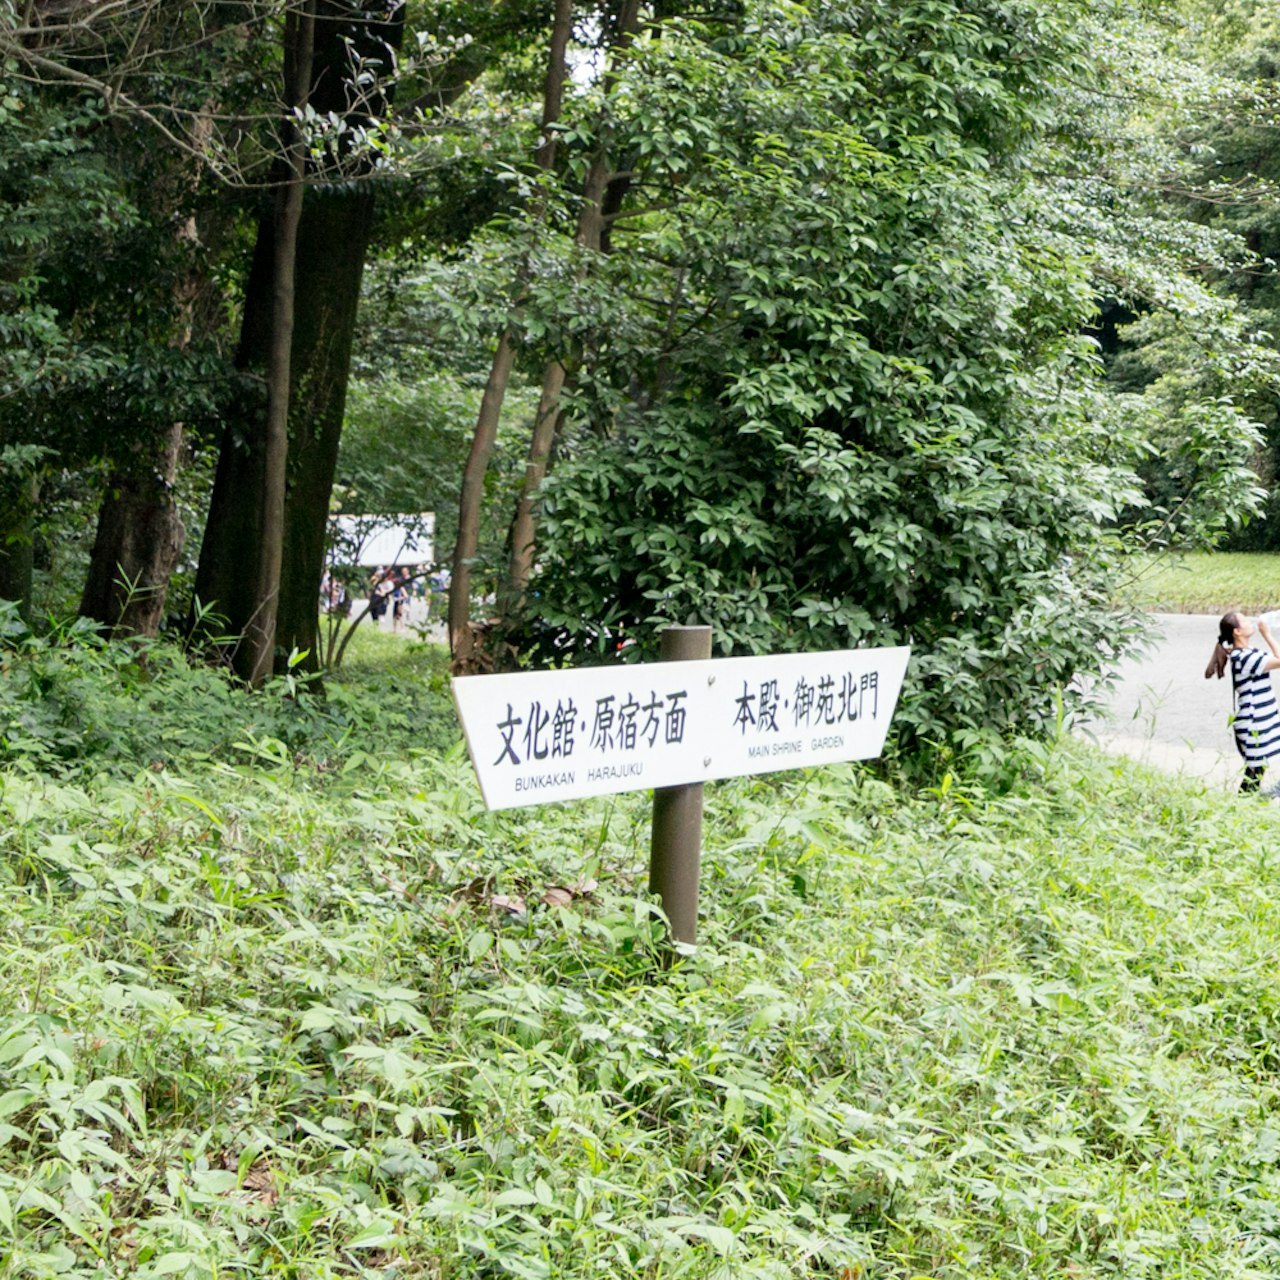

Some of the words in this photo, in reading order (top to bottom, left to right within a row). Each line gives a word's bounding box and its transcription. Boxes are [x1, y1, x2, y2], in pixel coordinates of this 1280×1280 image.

[733, 671, 879, 736] 本殿・御苑北門
[493, 690, 688, 766] 文化館・原宿方面
[748, 744, 770, 758] MAIN
[772, 740, 802, 755] SHRINE
[811, 736, 844, 751] GARDEN
[515, 772, 575, 791] BUNKAKAN
[588, 763, 643, 781] HARAJUKU
